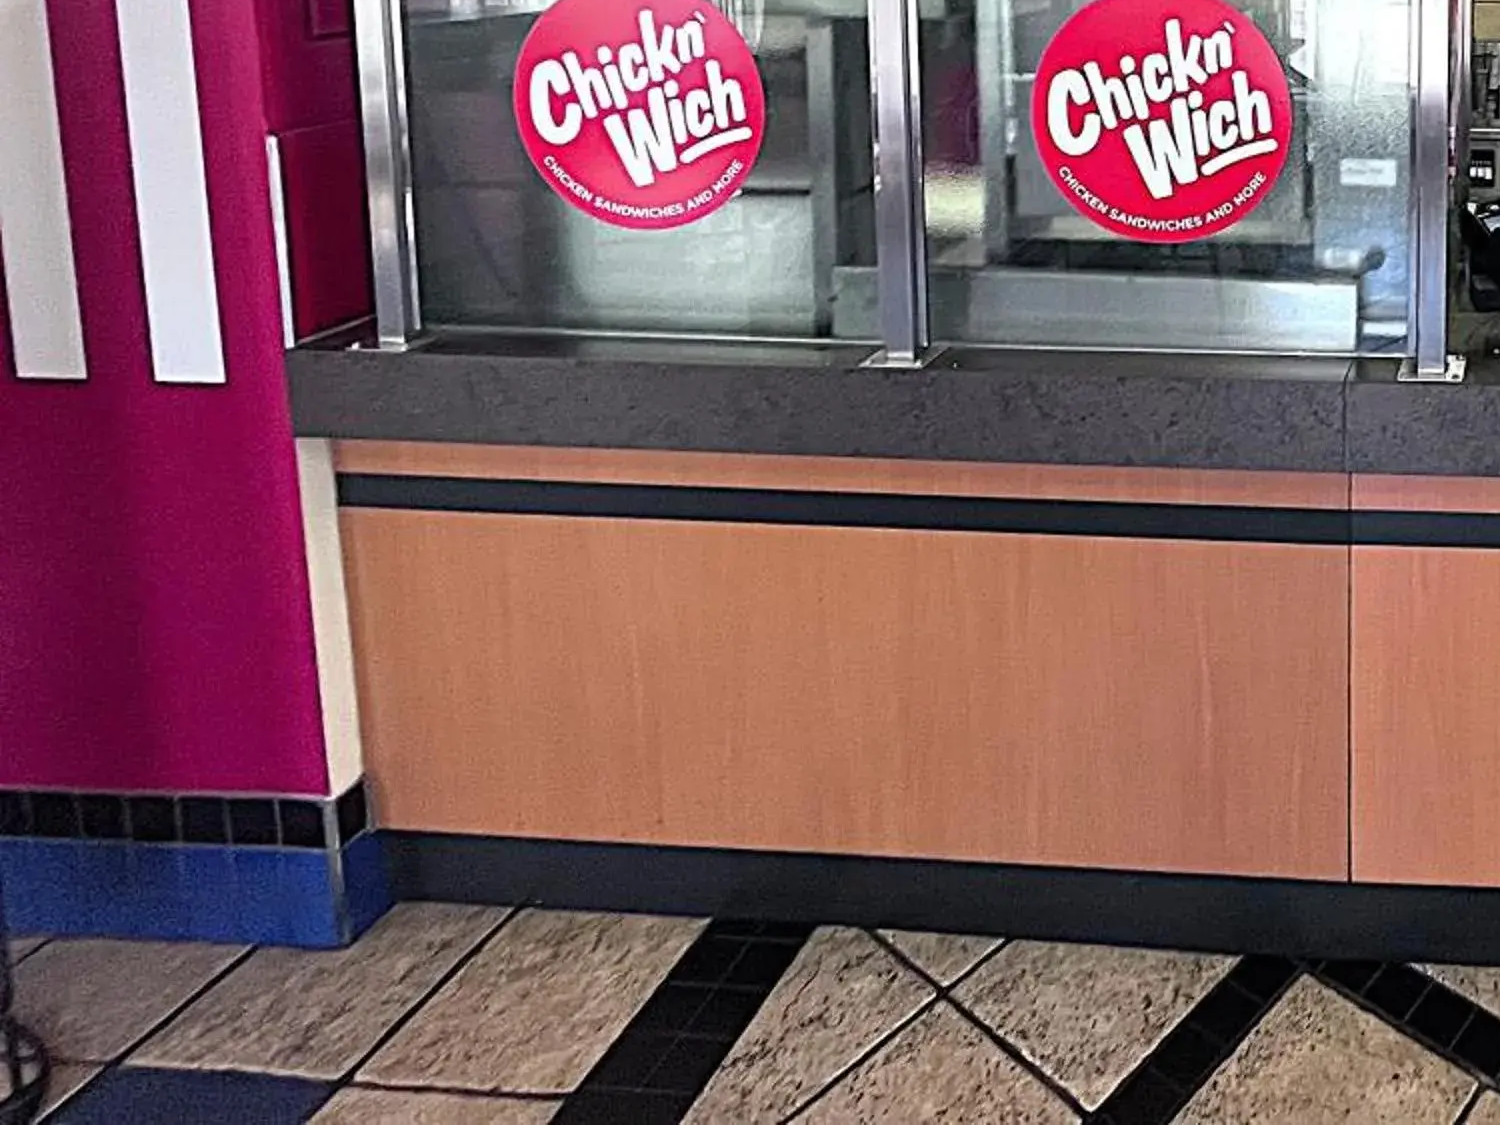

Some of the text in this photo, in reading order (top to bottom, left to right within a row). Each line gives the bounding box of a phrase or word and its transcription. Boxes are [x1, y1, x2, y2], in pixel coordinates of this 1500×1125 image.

[603, 59, 747, 188] Wich
[1123, 70, 1273, 200] Wich
[543, 155, 744, 219] CHICKEN SANDWICHES AND MORE
[1059, 166, 1267, 232] CHICKEN SANDWICHES AND MORE
